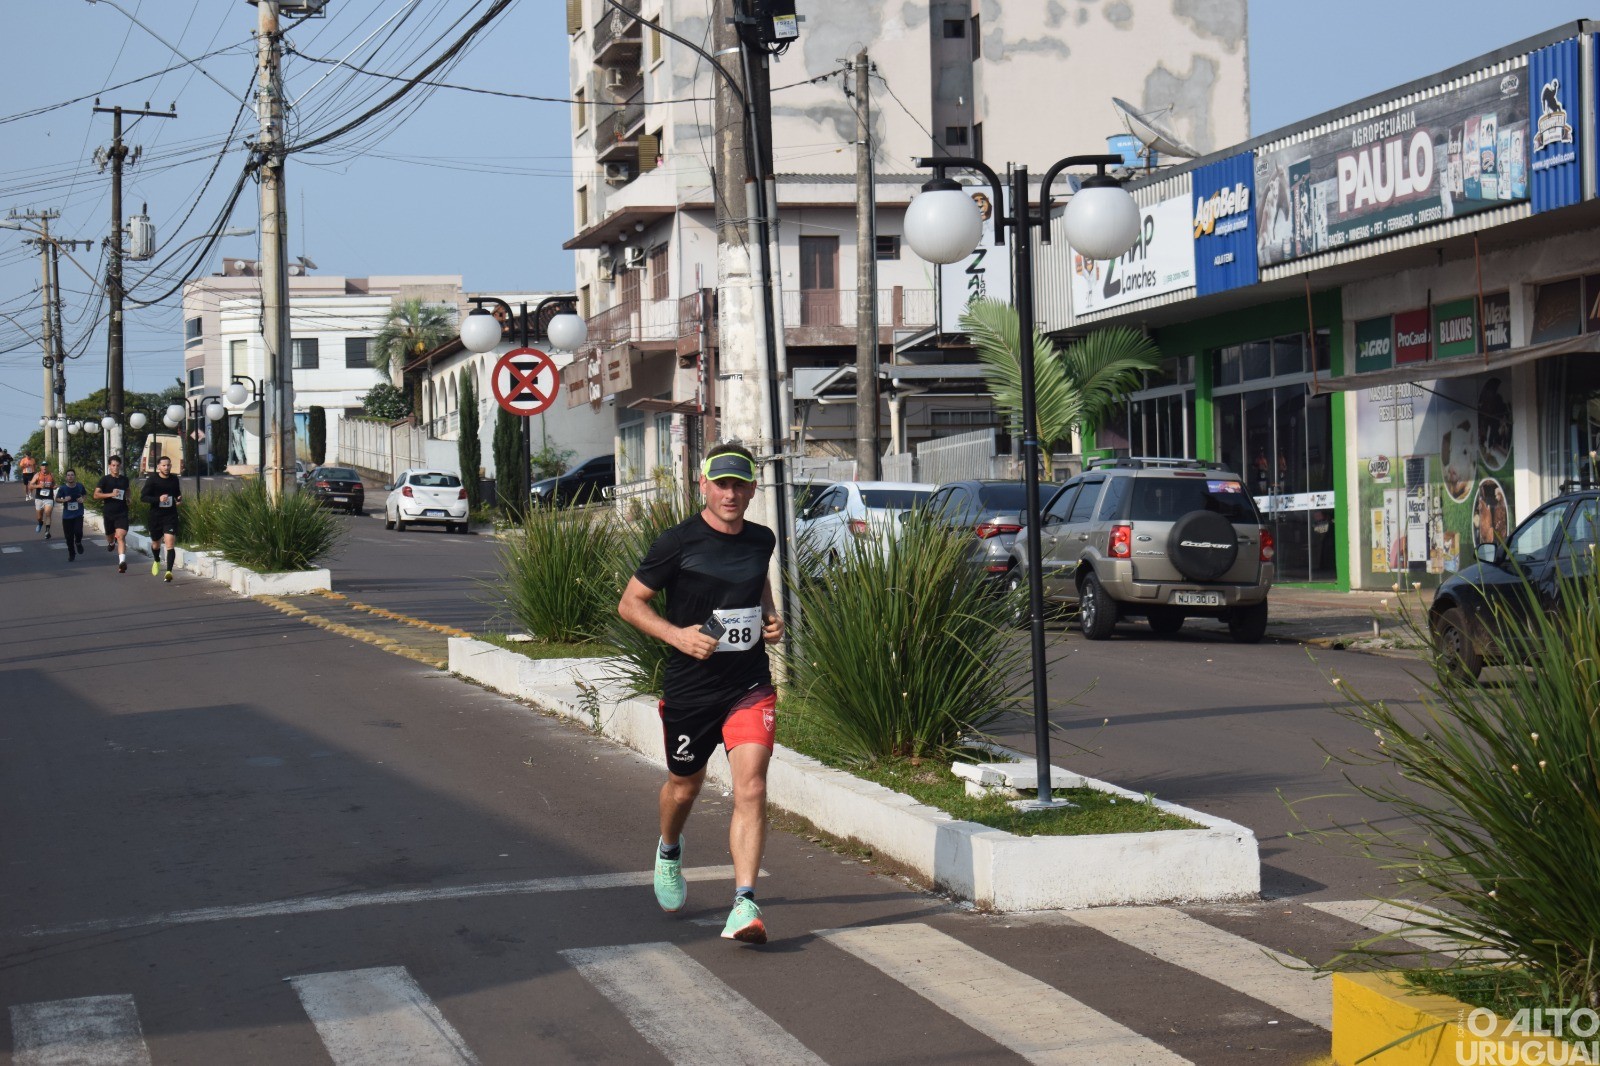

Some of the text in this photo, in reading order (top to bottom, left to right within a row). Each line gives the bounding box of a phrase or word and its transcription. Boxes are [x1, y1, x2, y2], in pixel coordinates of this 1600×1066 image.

[1351, 110, 1416, 148] AGROPECUÁRIA
[1337, 131, 1434, 214] PAULO
[1194, 182, 1250, 233] AgroBella
[1374, 221, 1383, 235] PET
[1121, 265, 1157, 294] Lanches
[1440, 316, 1472, 344] BLOKUS
[1484, 322, 1508, 346] milk
[1370, 461, 1388, 473] SUPRA
[1408, 512, 1421, 524] milk
[728, 627, 752, 644] 88
[676, 734, 691, 755] 2
